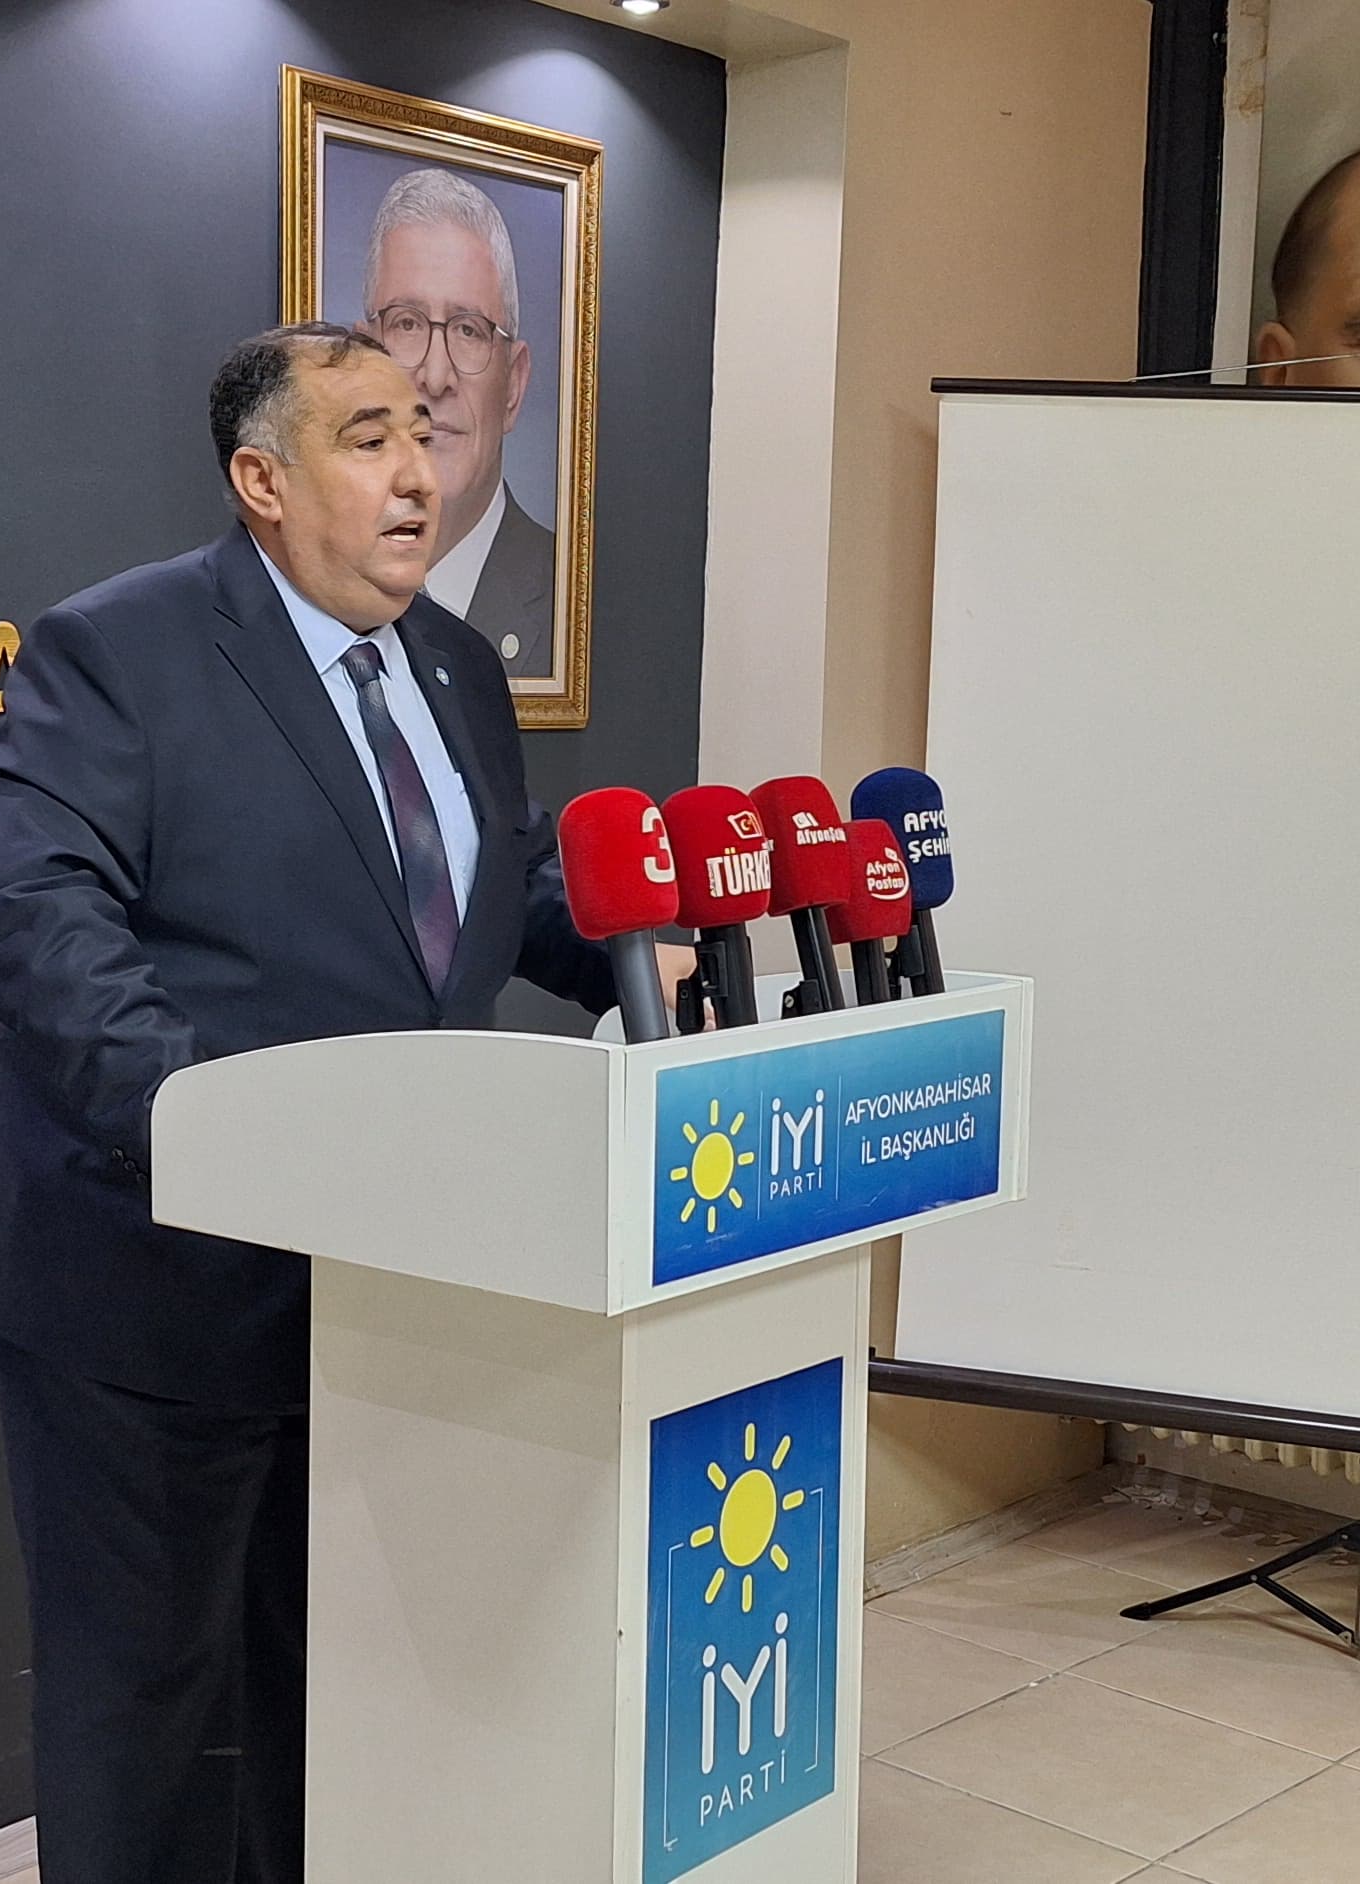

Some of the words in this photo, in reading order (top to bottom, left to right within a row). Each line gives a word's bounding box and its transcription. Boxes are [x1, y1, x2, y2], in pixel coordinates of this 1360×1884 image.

[642, 806, 676, 883] 3
[866, 861, 901, 877] Afyon
[845, 1073, 991, 1126] AFYONKARAHİSAR
[770, 1089, 824, 1176] İYİ
[861, 1136, 876, 1165] İL
[881, 1112, 975, 1160] BAŞKANLIĞI
[769, 1166, 822, 1200] PARTİ
[701, 1612, 788, 1774] İYİ
[700, 1749, 785, 1827] PARTİ
